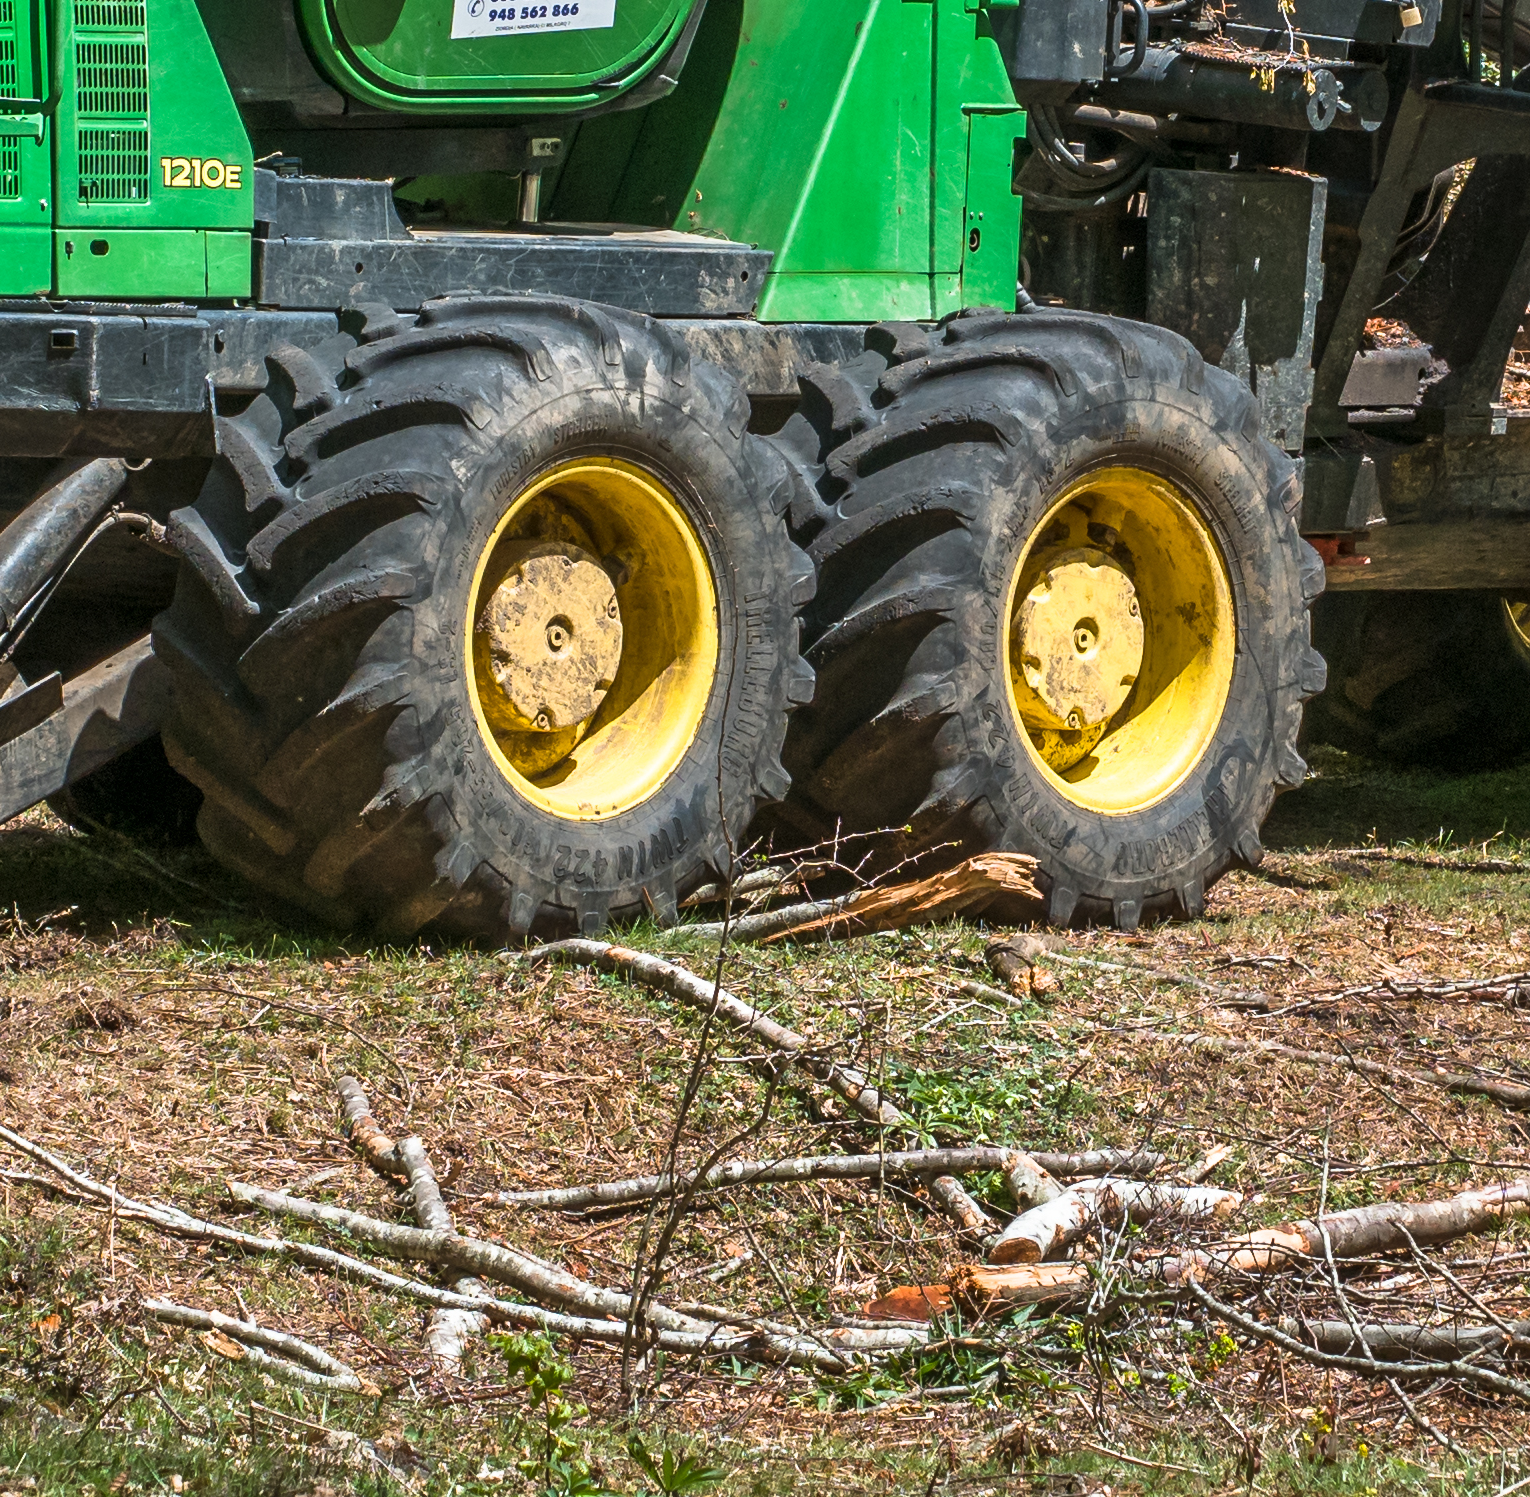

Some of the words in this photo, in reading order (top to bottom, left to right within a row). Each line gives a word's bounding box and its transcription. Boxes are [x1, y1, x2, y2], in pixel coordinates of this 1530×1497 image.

[488, 7, 516, 22] 948
[520, 5, 548, 19] 562
[552, 3, 579, 17] 866
[160, 157, 242, 189] 1210E
[721, 585, 774, 778] TRELLEBORG
[1009, 773, 1068, 849] TWIN
[553, 845, 608, 885] 422
[618, 817, 689, 881] TWIN
